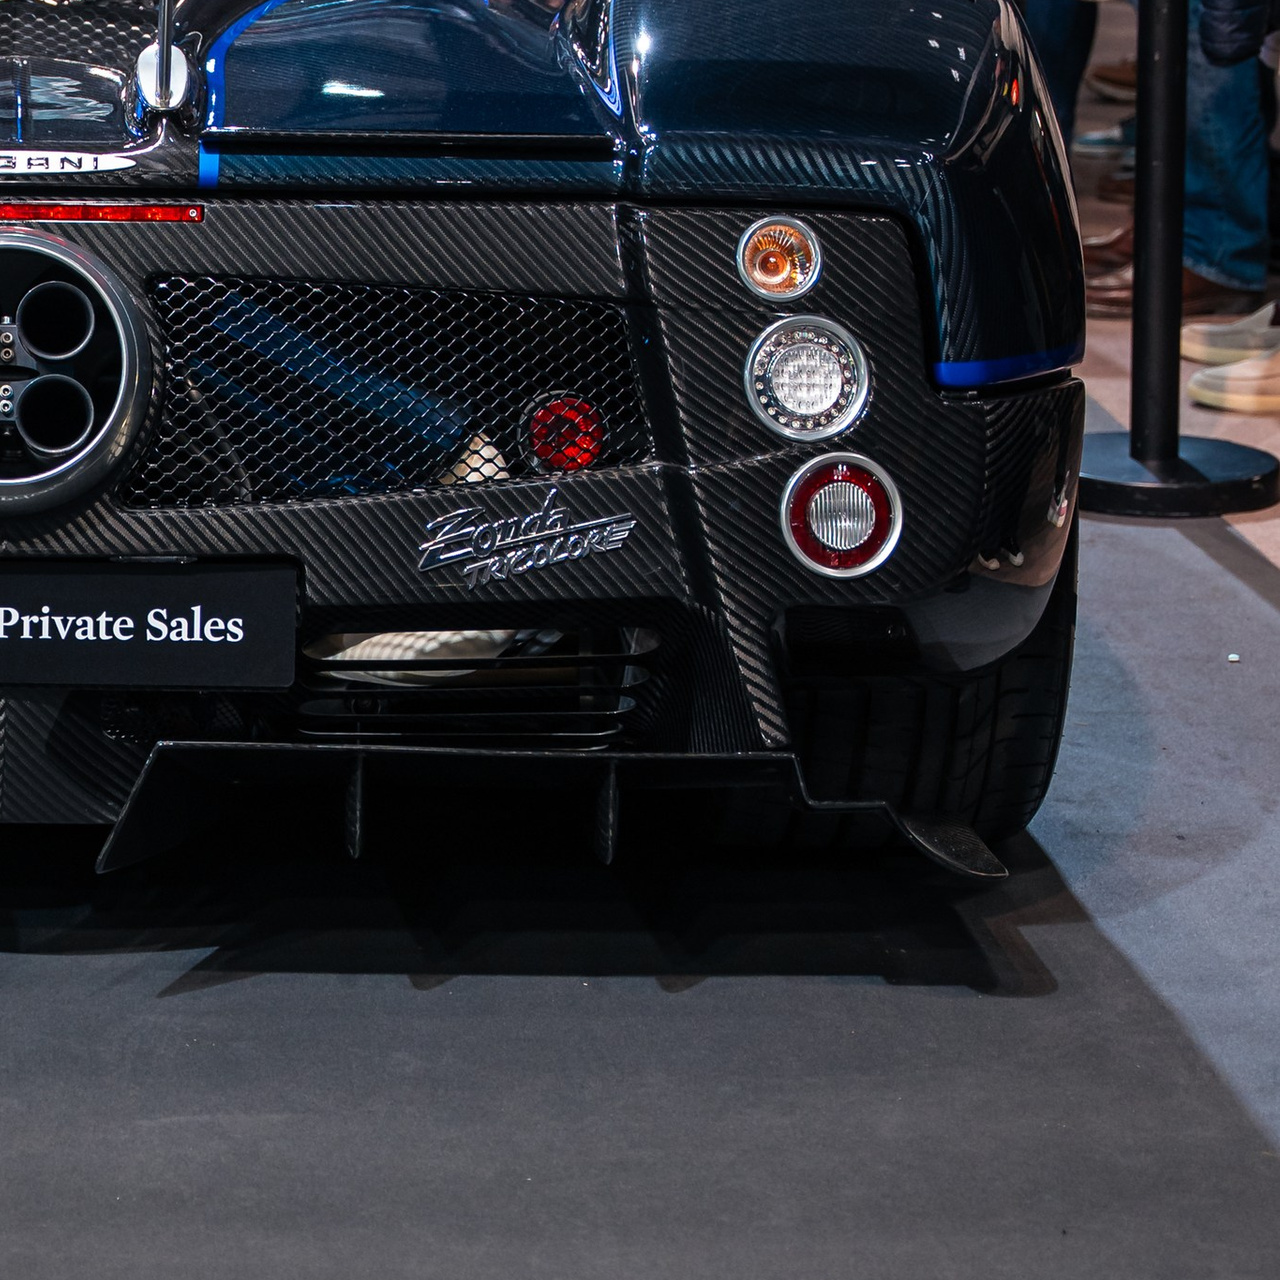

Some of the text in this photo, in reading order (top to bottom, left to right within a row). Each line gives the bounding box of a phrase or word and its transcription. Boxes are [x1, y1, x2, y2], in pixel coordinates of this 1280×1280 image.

[418, 488, 570, 571] Zonda
[462, 520, 637, 590] TRICOLORE
[145, 604, 244, 643] Sales
